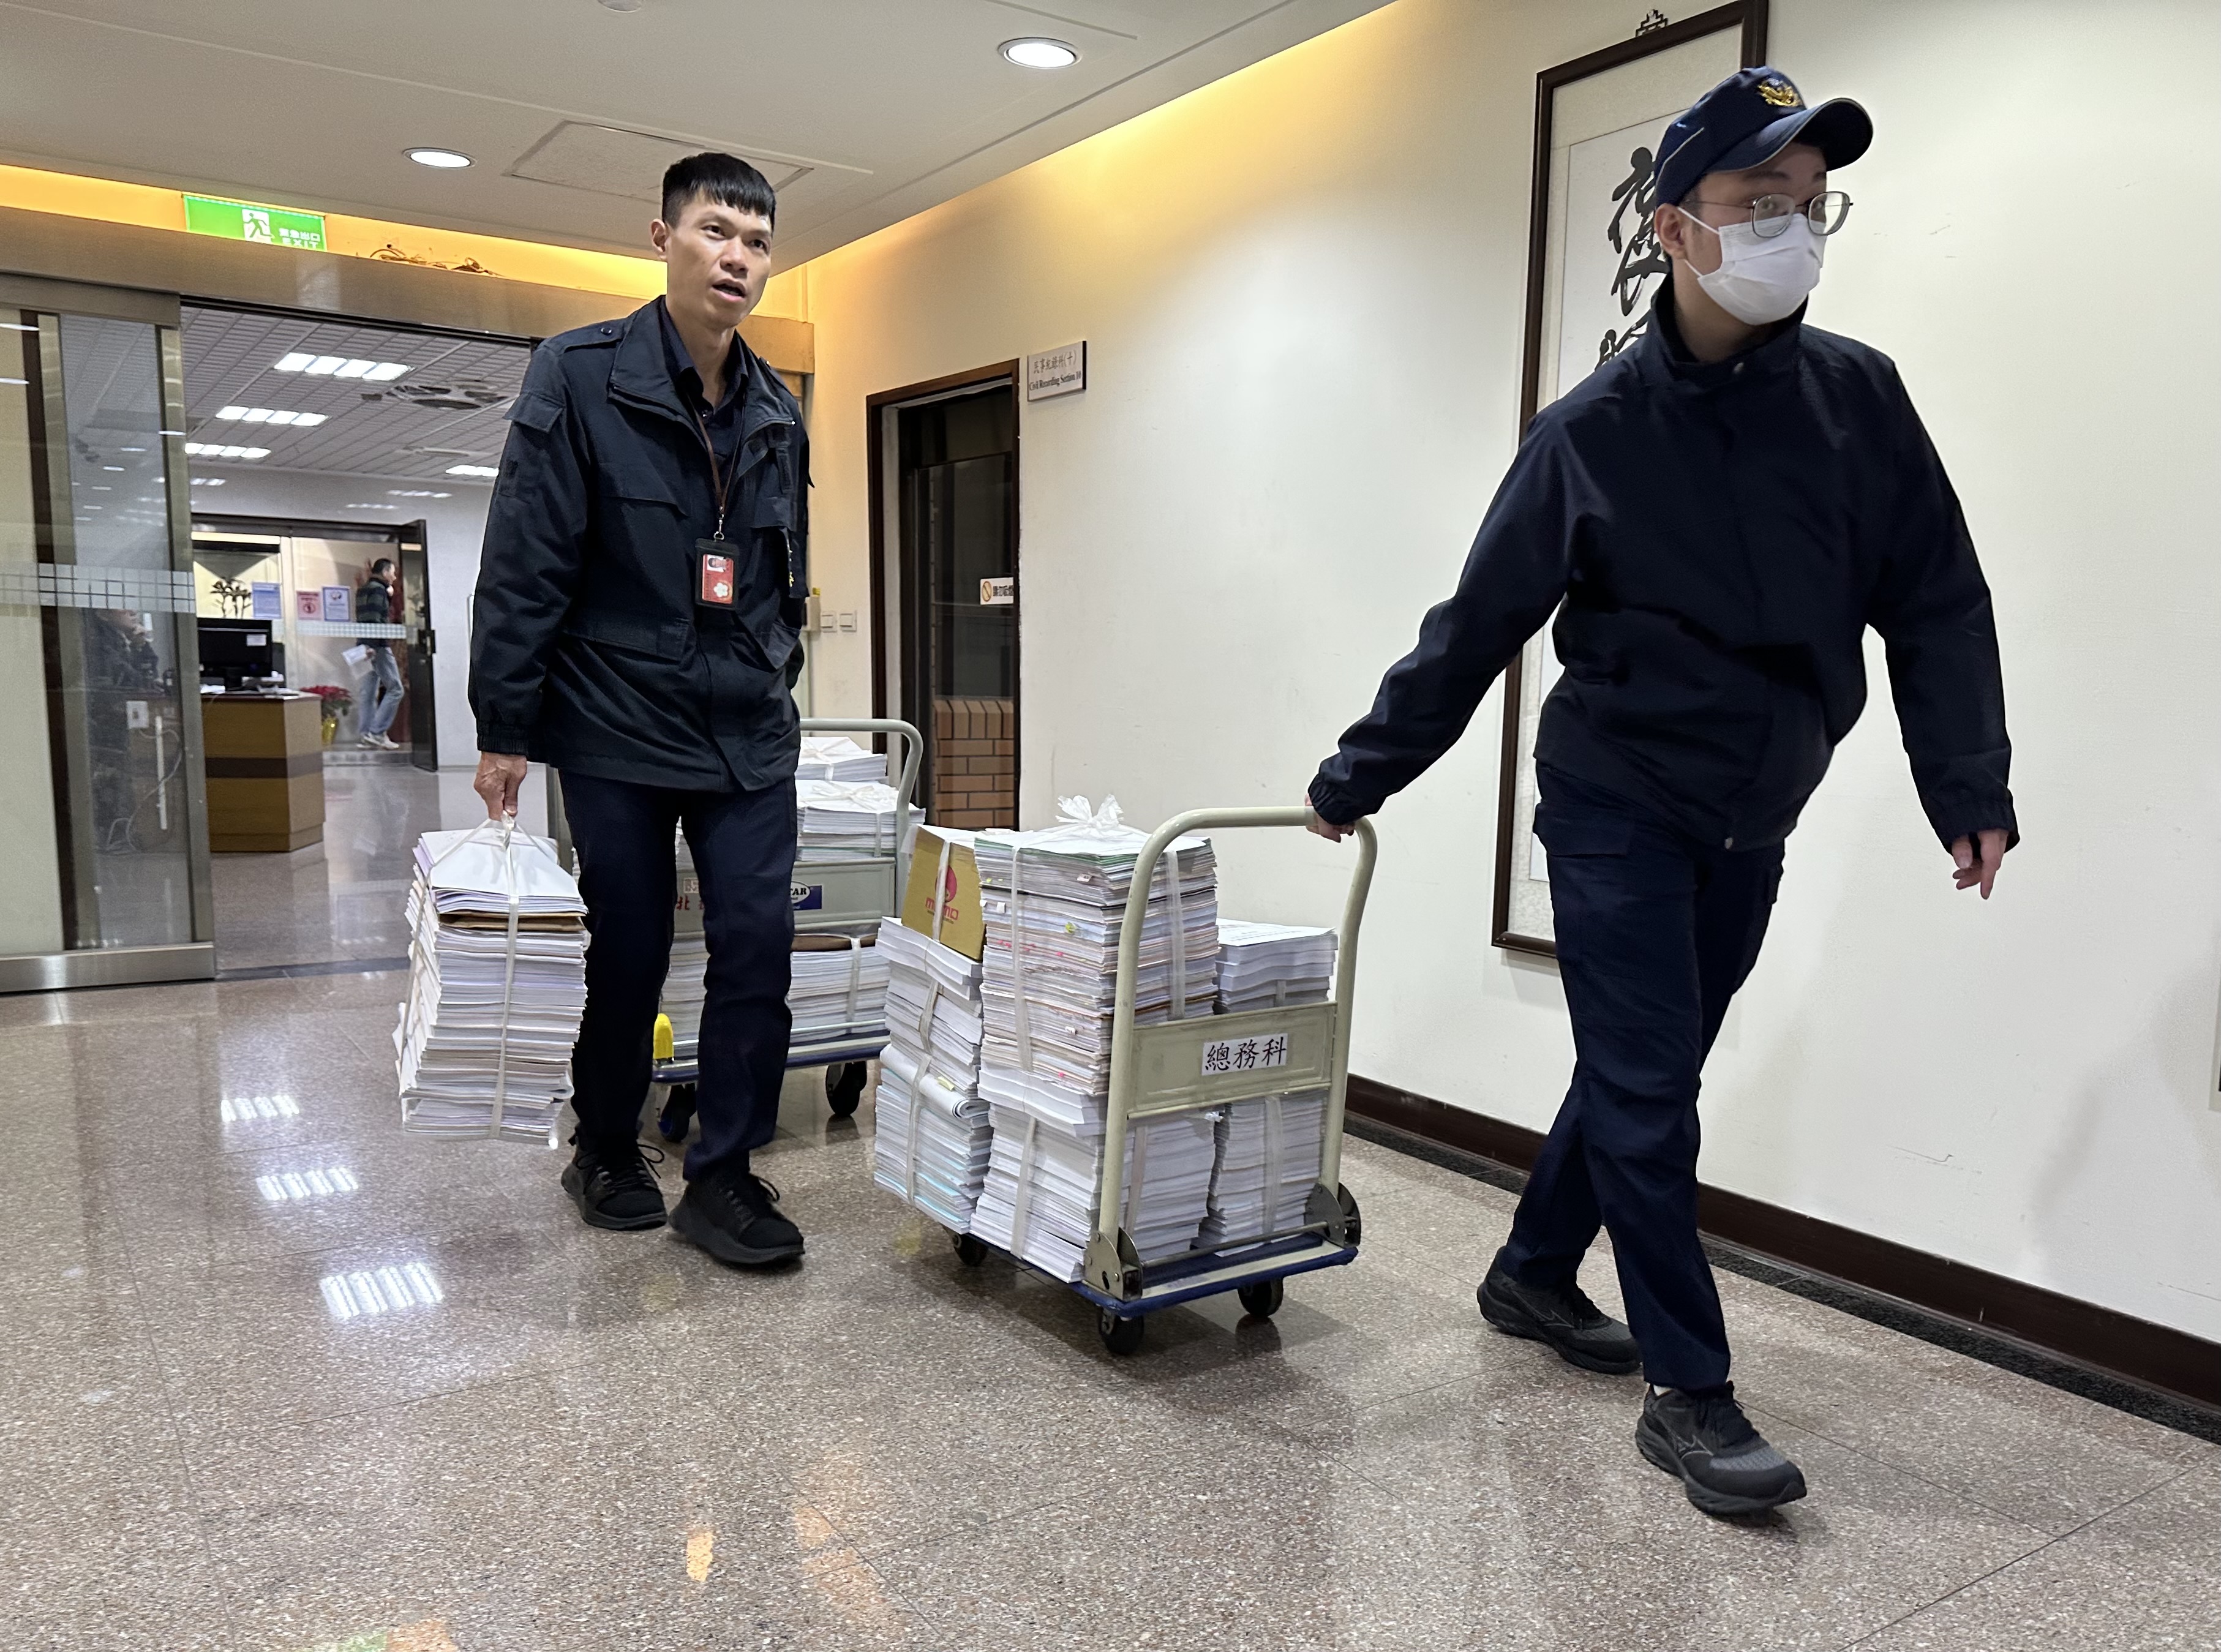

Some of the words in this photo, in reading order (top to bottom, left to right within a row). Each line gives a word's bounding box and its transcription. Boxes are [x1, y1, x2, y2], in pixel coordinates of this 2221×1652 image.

[282, 237, 318, 249] EXIT
[1061, 372, 1075, 384] Section
[925, 897, 959, 920] mmo
[1205, 1037, 1287, 1071] 總務科
